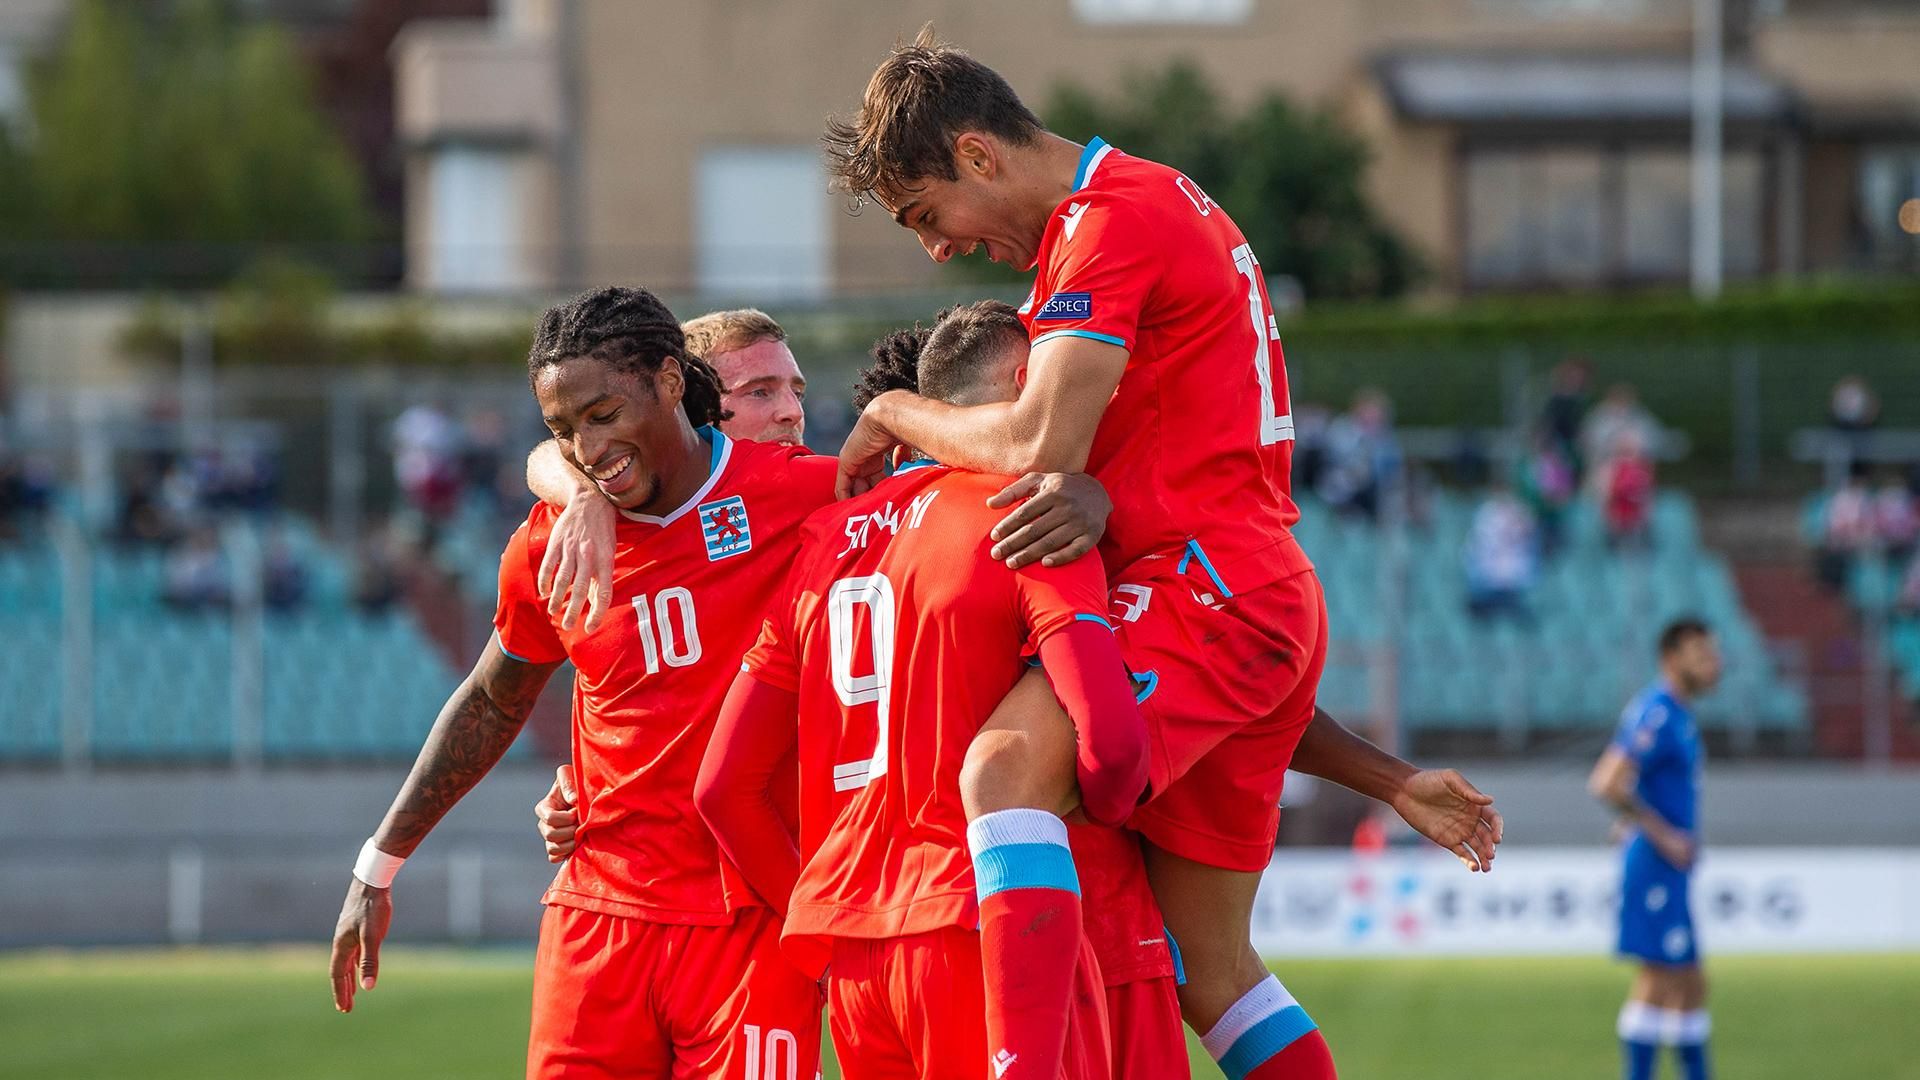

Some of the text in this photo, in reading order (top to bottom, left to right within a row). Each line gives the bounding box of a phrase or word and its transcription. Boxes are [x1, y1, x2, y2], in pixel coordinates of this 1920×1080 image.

[632, 586, 702, 675] 10
[828, 572, 895, 792] 9
[743, 1024, 798, 1080] 10
